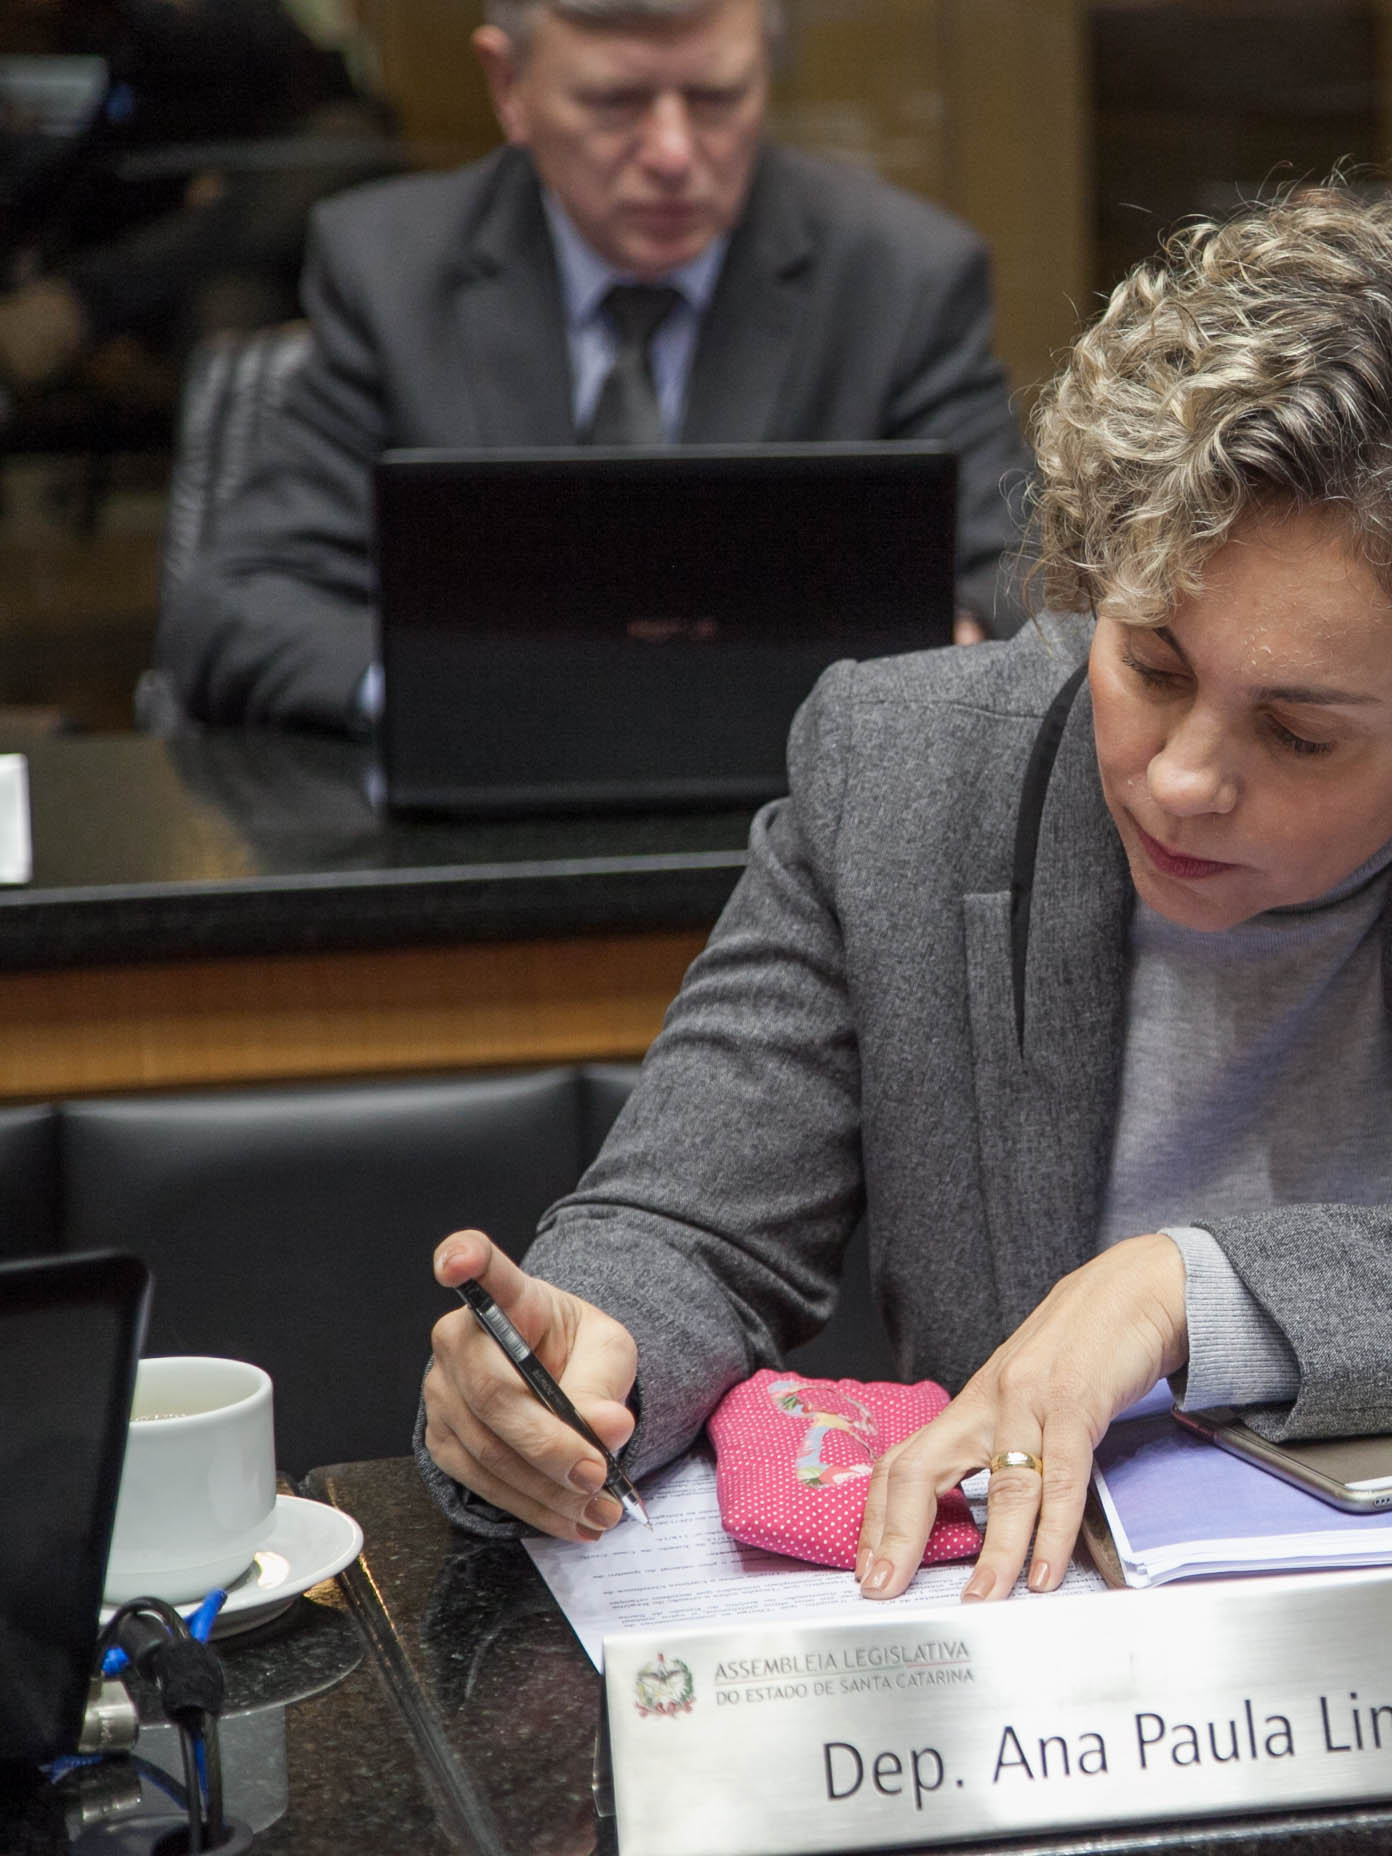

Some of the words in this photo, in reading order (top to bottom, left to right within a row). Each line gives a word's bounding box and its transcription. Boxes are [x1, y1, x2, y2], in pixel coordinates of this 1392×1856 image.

[714, 1653, 837, 1681] ASSEMBLEIA
[842, 1640, 969, 1668] LEGISLATIVA
[716, 1690, 741, 1706] DO
[747, 1682, 808, 1703] ESTADO
[814, 1681, 834, 1697] DE
[840, 1673, 893, 1694] SANTA
[896, 1670, 974, 1689] CATARINA
[823, 1742, 964, 1811] Dep.
[992, 1725, 1108, 1784] Ana
[1134, 1699, 1295, 1770] Paula
